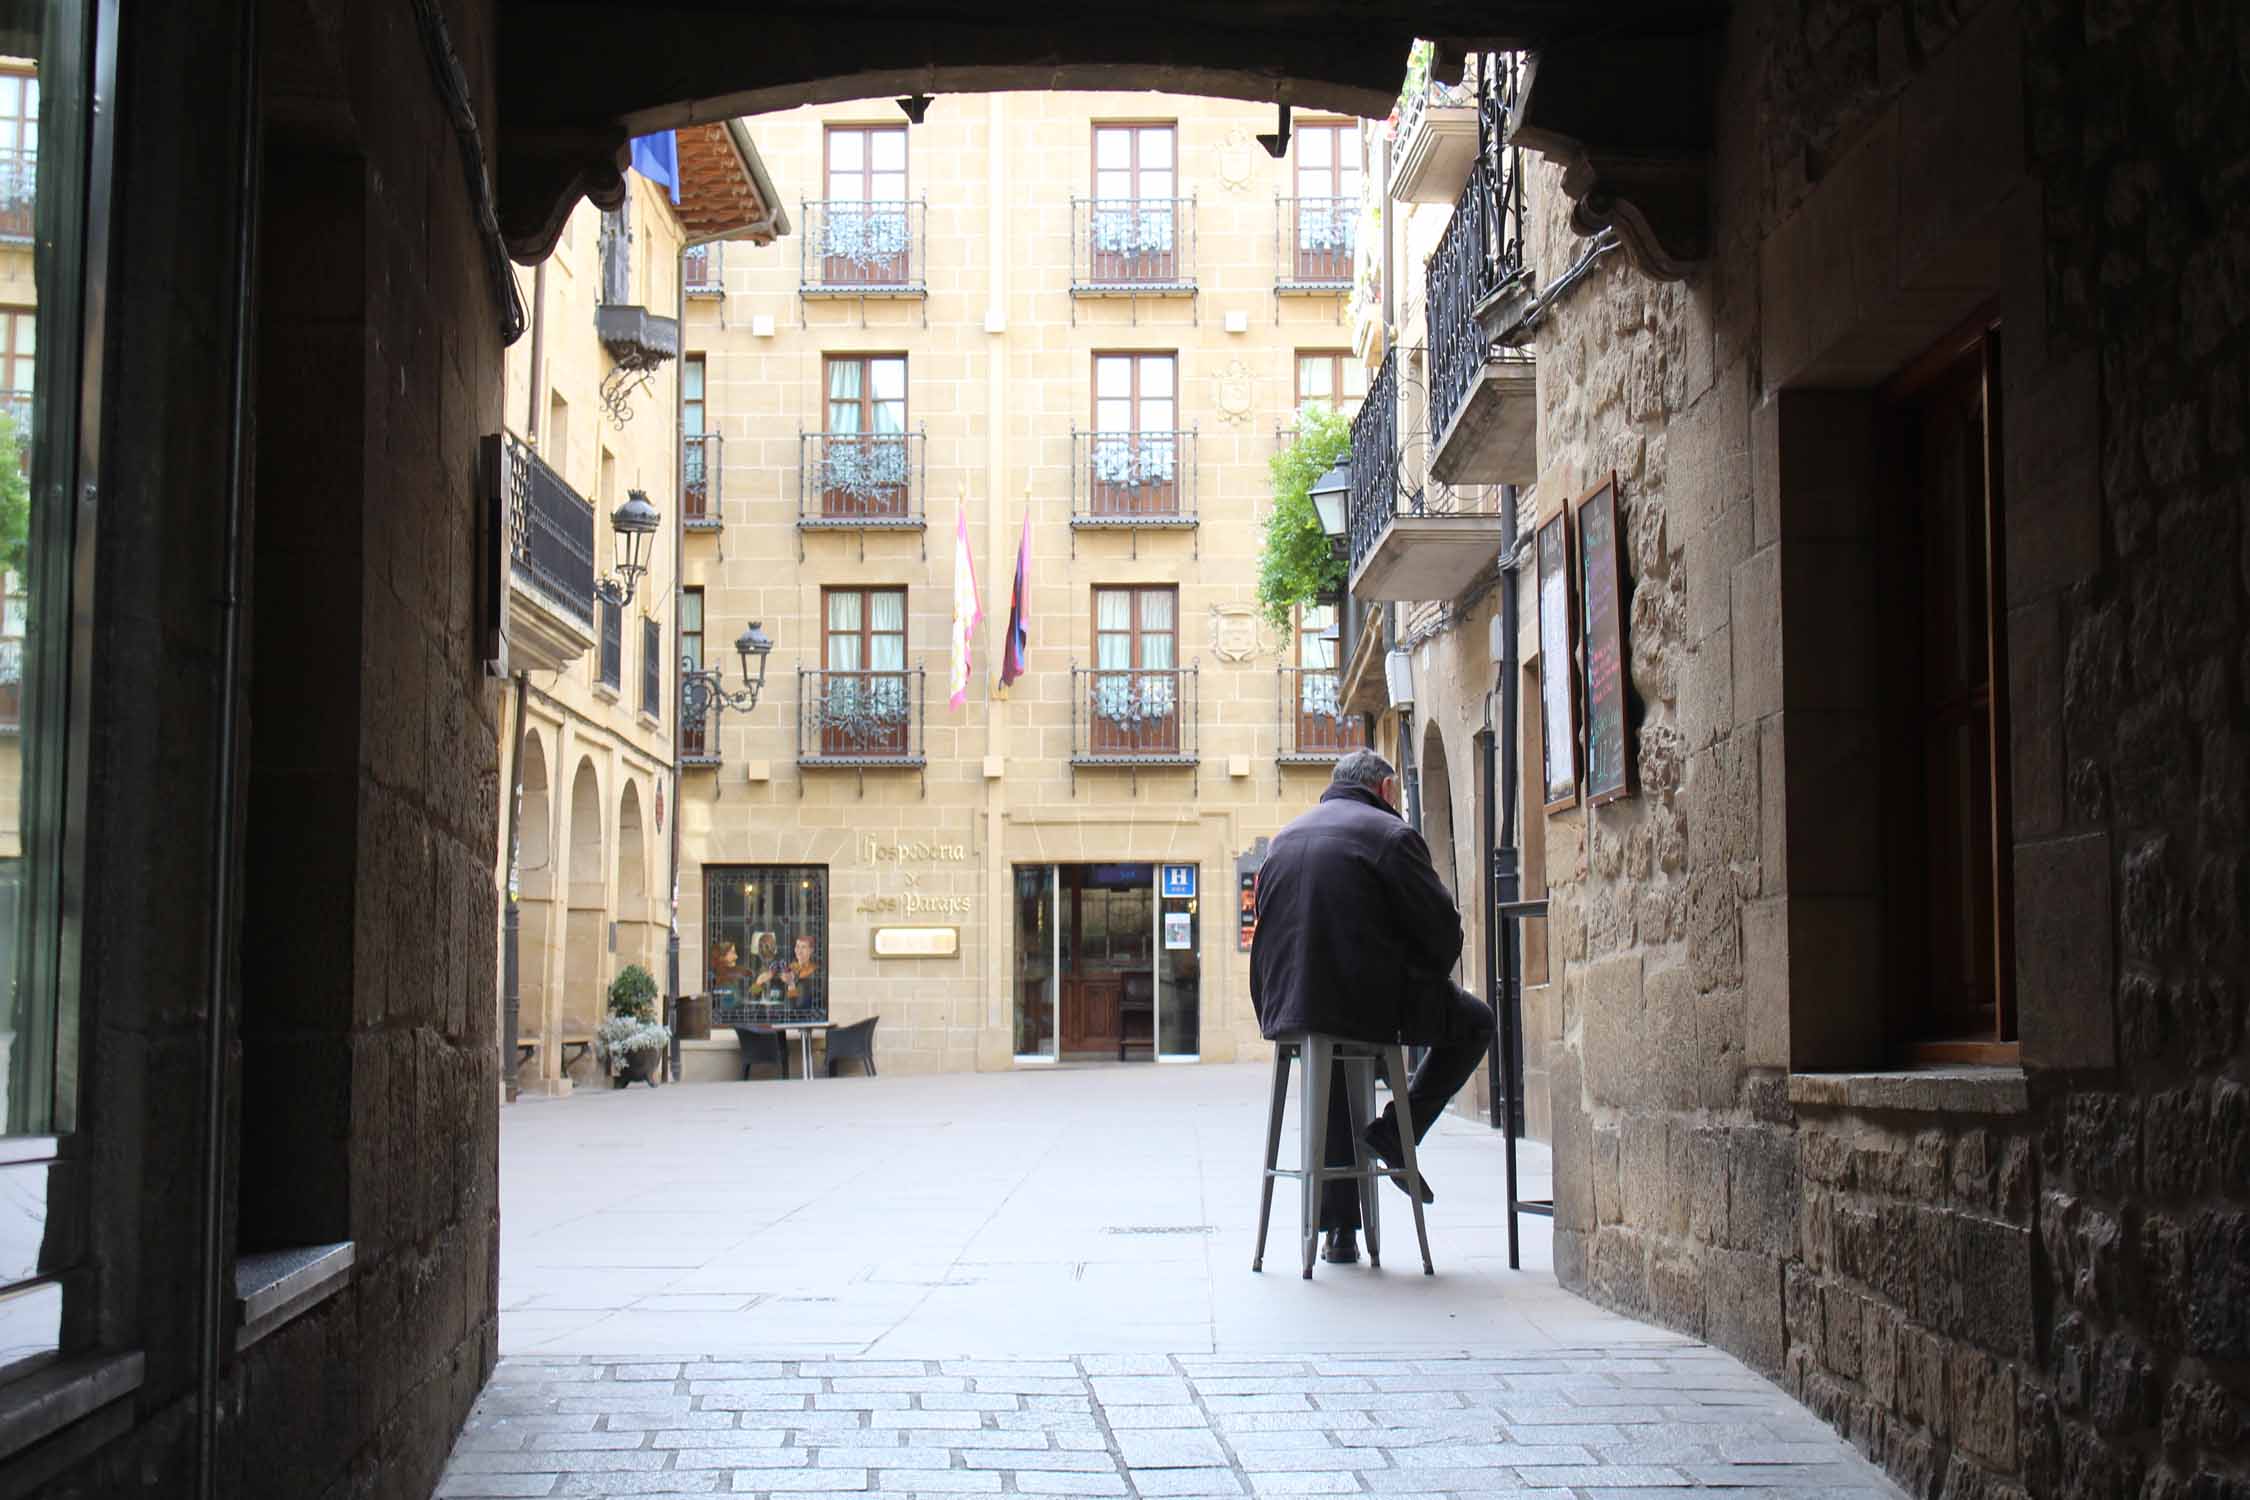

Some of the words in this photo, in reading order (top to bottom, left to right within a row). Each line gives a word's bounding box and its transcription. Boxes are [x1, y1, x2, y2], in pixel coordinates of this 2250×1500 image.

[1171, 868, 1188, 885] H
[857, 894, 896, 913] Los
[902, 891, 971, 918] Parajes
